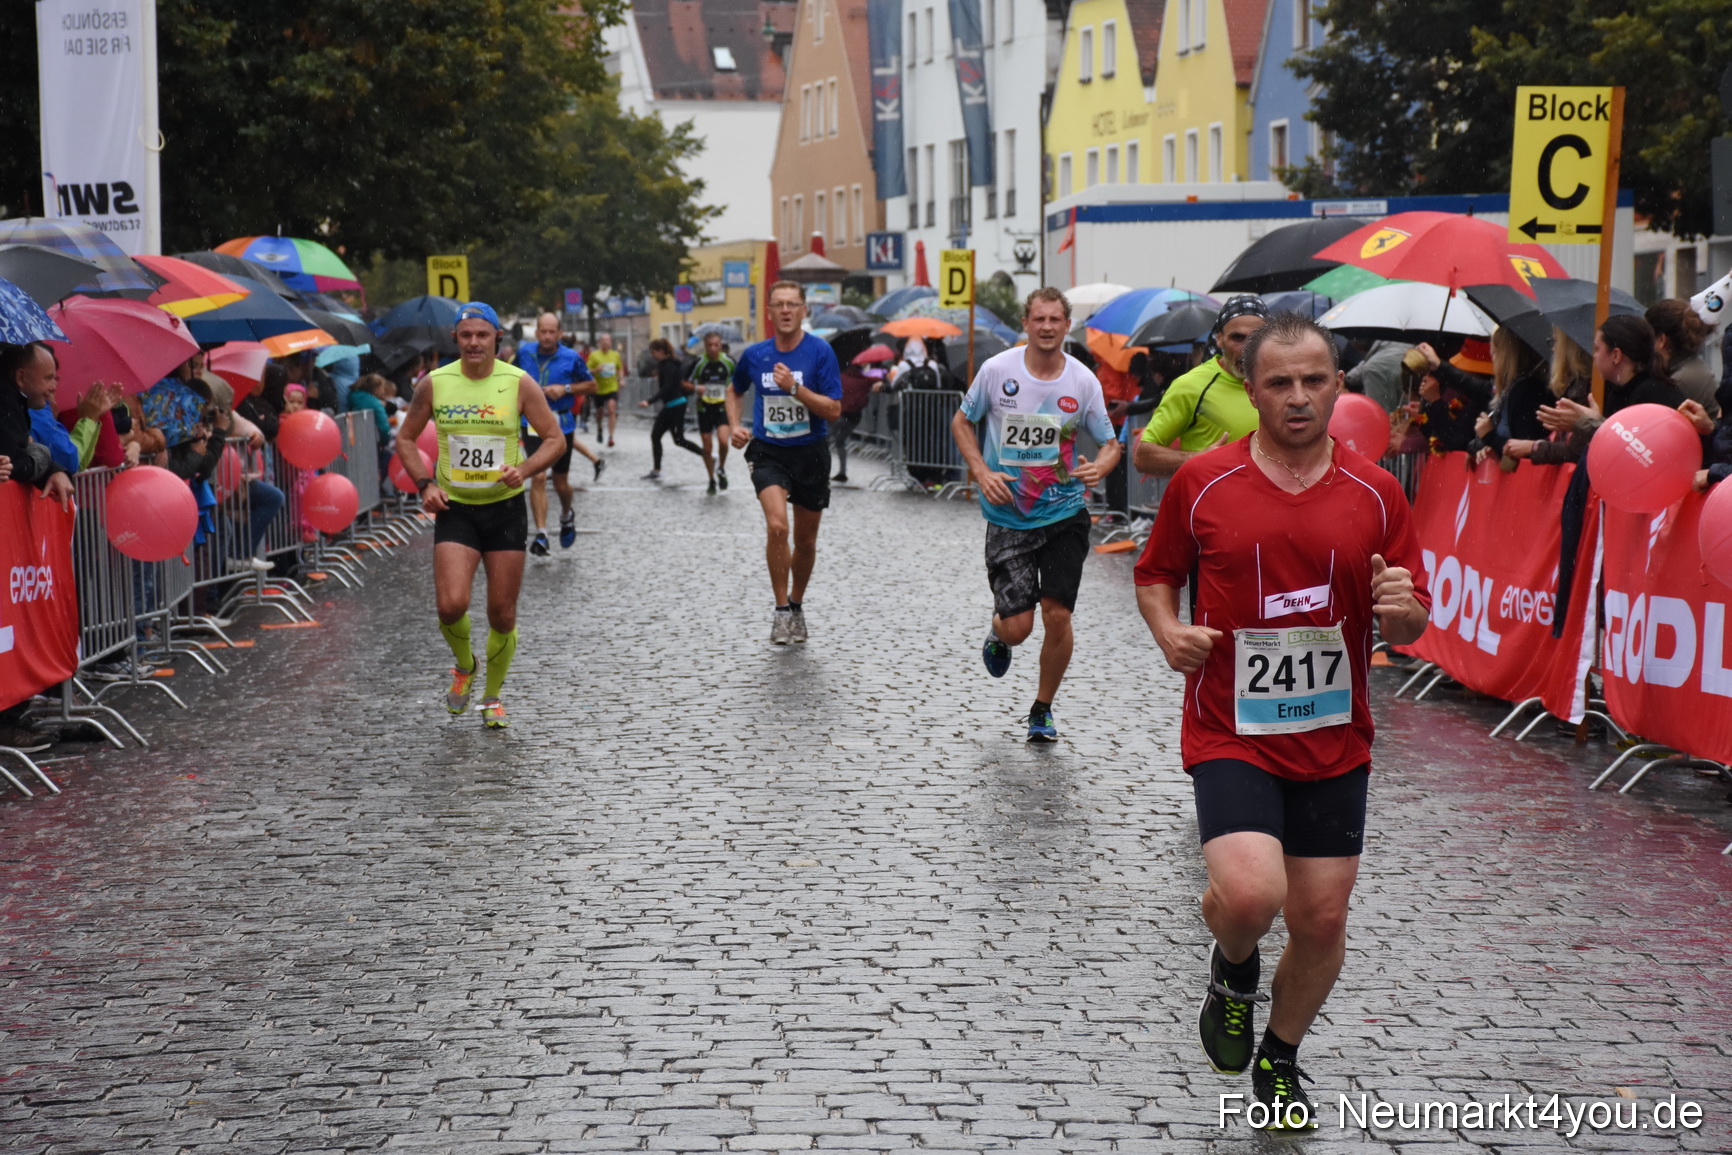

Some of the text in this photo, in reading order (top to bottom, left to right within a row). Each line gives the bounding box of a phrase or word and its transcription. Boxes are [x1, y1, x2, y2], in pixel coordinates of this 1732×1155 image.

[1528, 93, 1610, 121] Block
[1537, 134, 1593, 211] C
[432, 258, 462, 270] Block
[944, 250, 971, 262] Block
[439, 274, 459, 300] D
[949, 267, 966, 296] D
[768, 406, 804, 422] 2518
[1006, 425, 1056, 446] 2439
[459, 448, 495, 468] 284
[1017, 450, 1043, 460] Tobias
[464, 472, 488, 481] Detlef
[1283, 595, 1312, 608] DEHN
[1288, 629, 1341, 644] BOCK
[1248, 650, 1343, 693] 2417
[1277, 700, 1316, 719] Ernst
